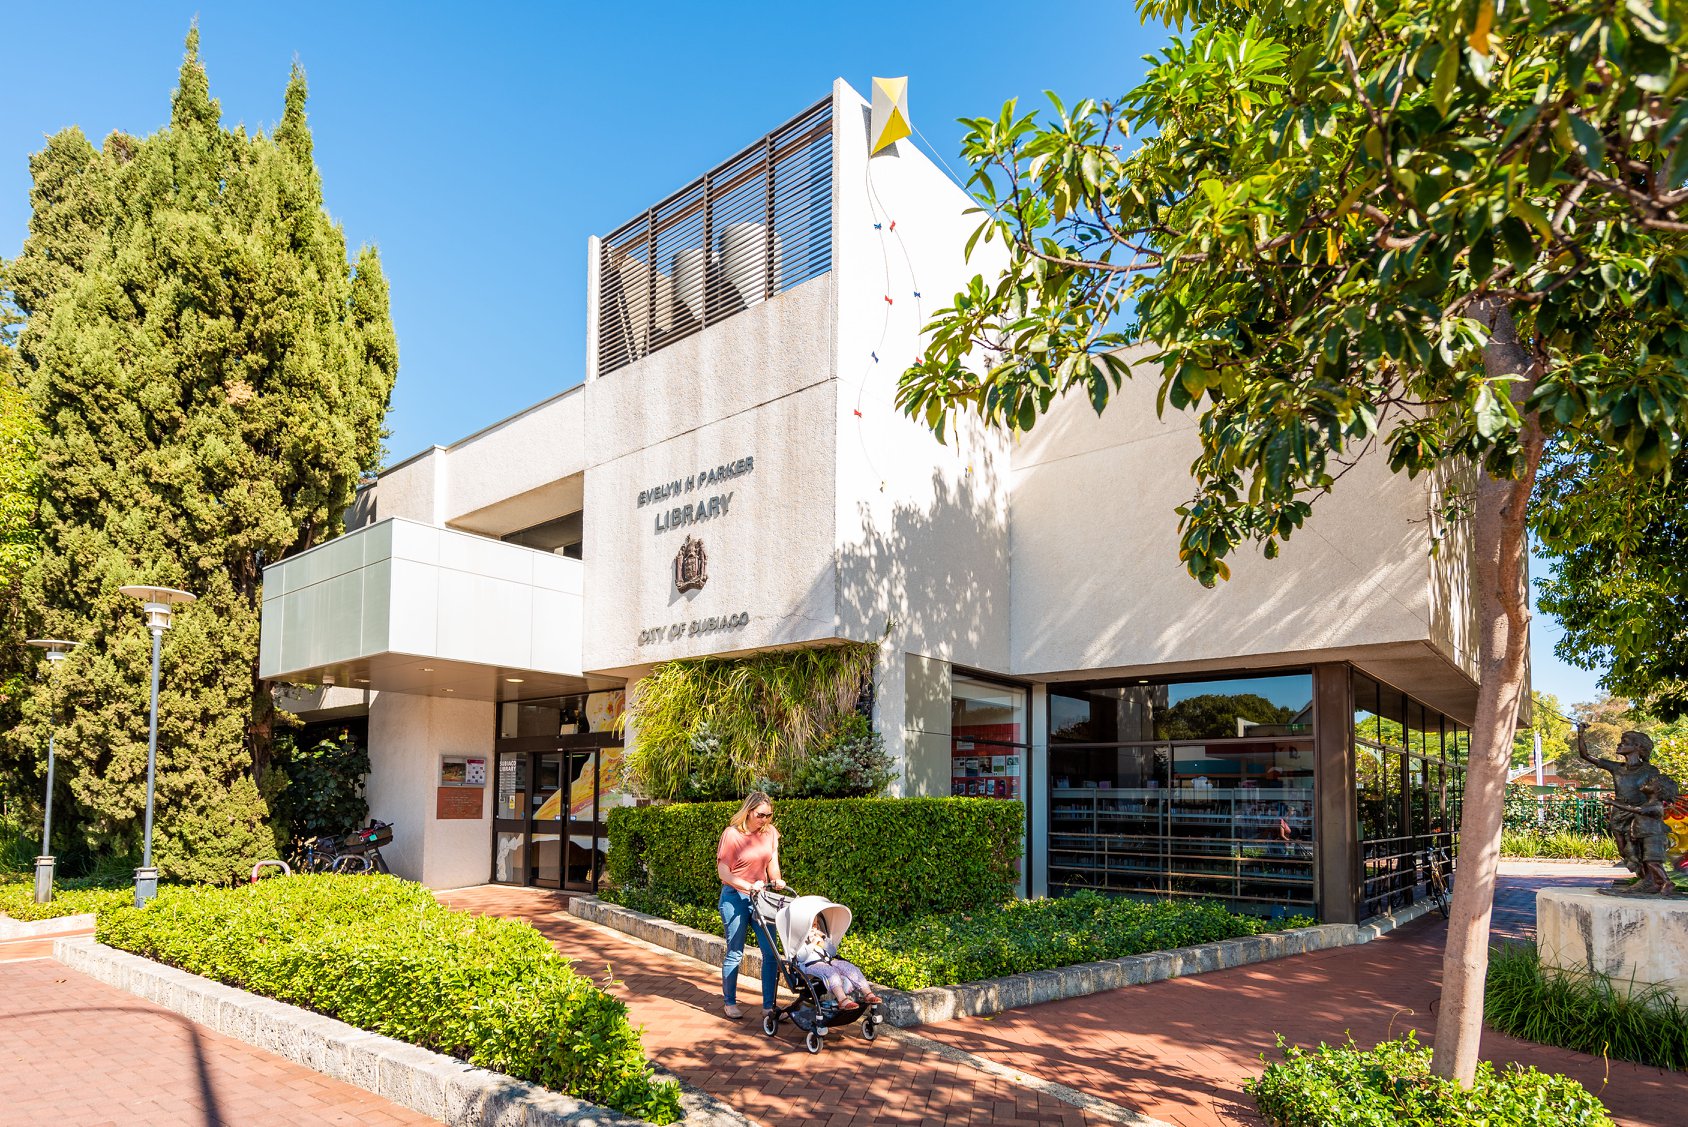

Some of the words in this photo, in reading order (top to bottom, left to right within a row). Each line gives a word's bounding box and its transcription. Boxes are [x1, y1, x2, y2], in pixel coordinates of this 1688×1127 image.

[639, 478, 683, 506] EVELYN
[685, 475, 695, 493] H
[698, 455, 754, 487] PARKER
[655, 491, 734, 532] LIBRARY
[640, 625, 667, 643] CITY
[670, 622, 686, 638] OF
[690, 611, 749, 635] SUBIACO
